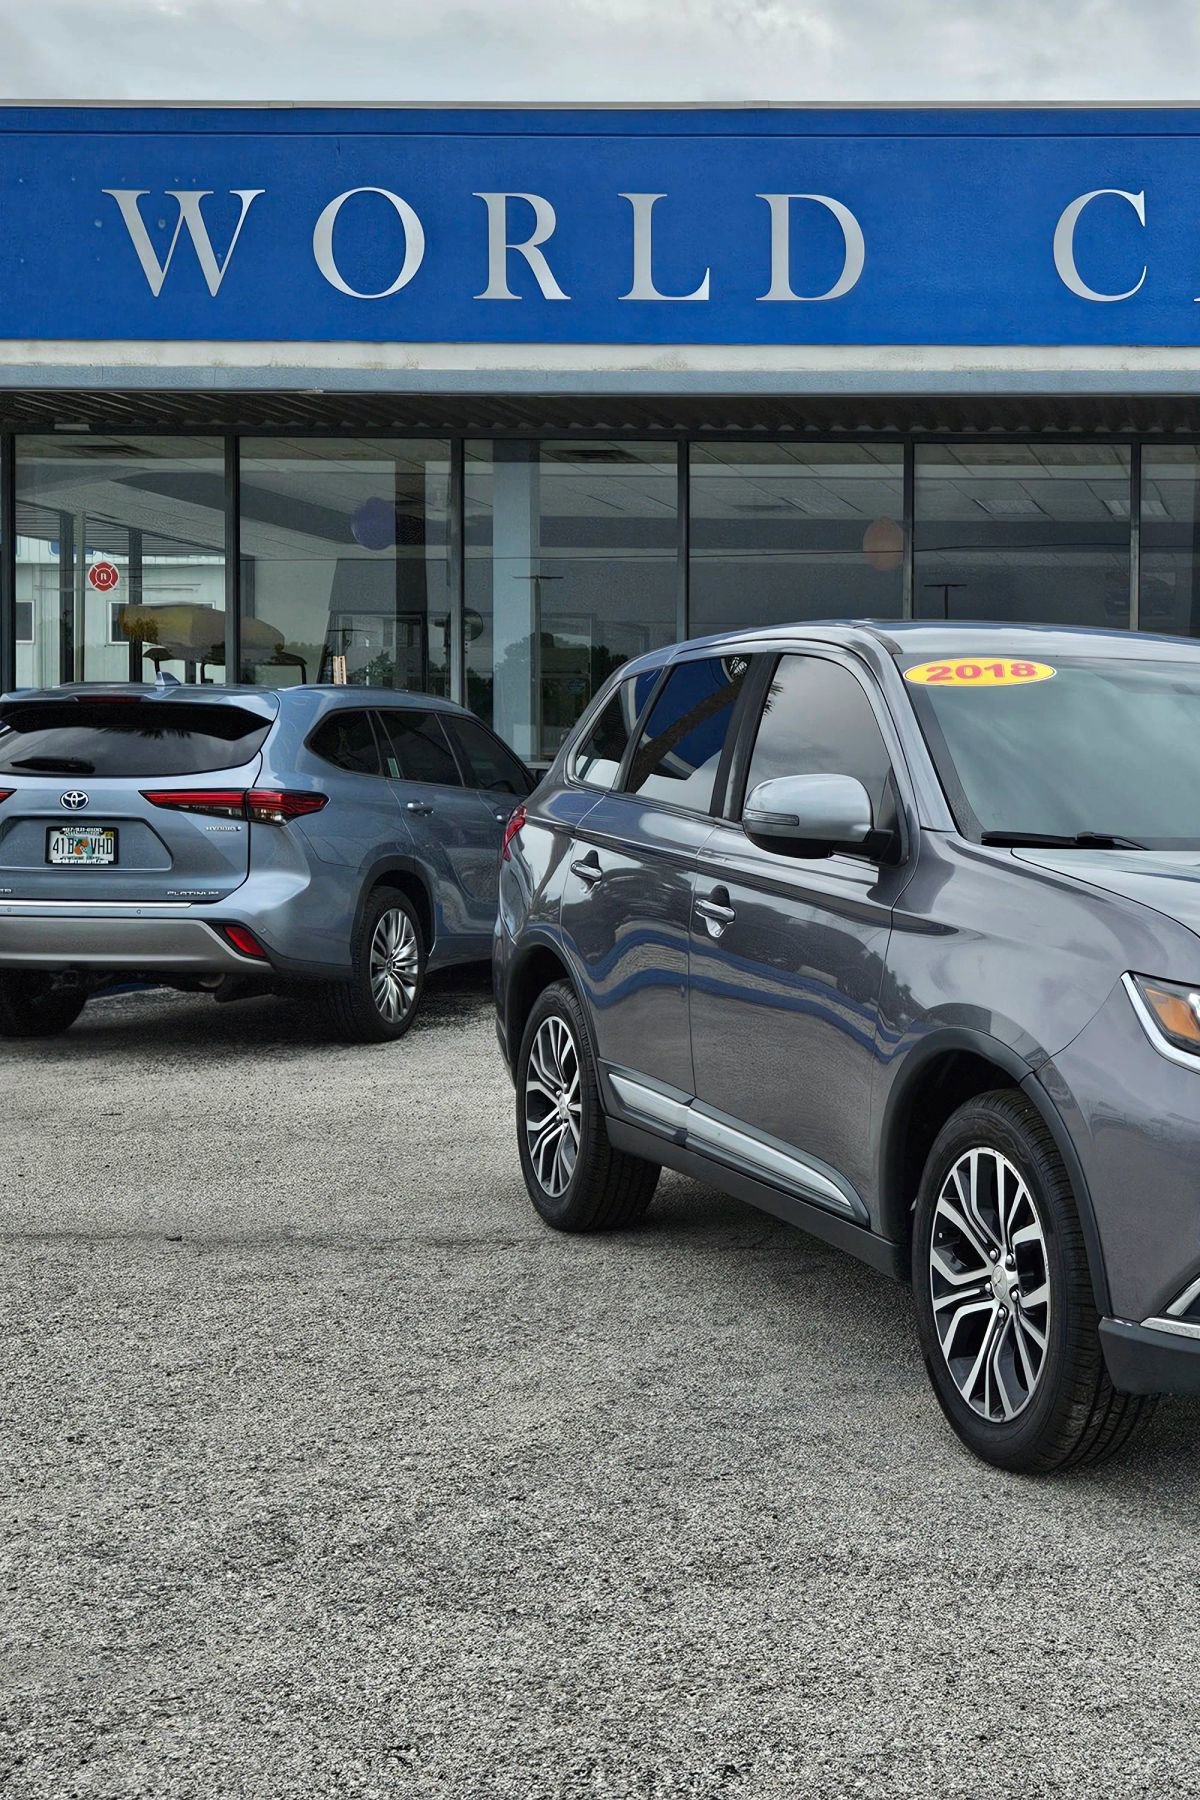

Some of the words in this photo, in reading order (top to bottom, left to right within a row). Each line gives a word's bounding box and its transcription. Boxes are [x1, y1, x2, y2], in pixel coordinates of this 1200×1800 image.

[102, 185, 865, 301] WORLD
[926, 663, 1037, 682] 2018
[90, 837, 113, 855] VHD
